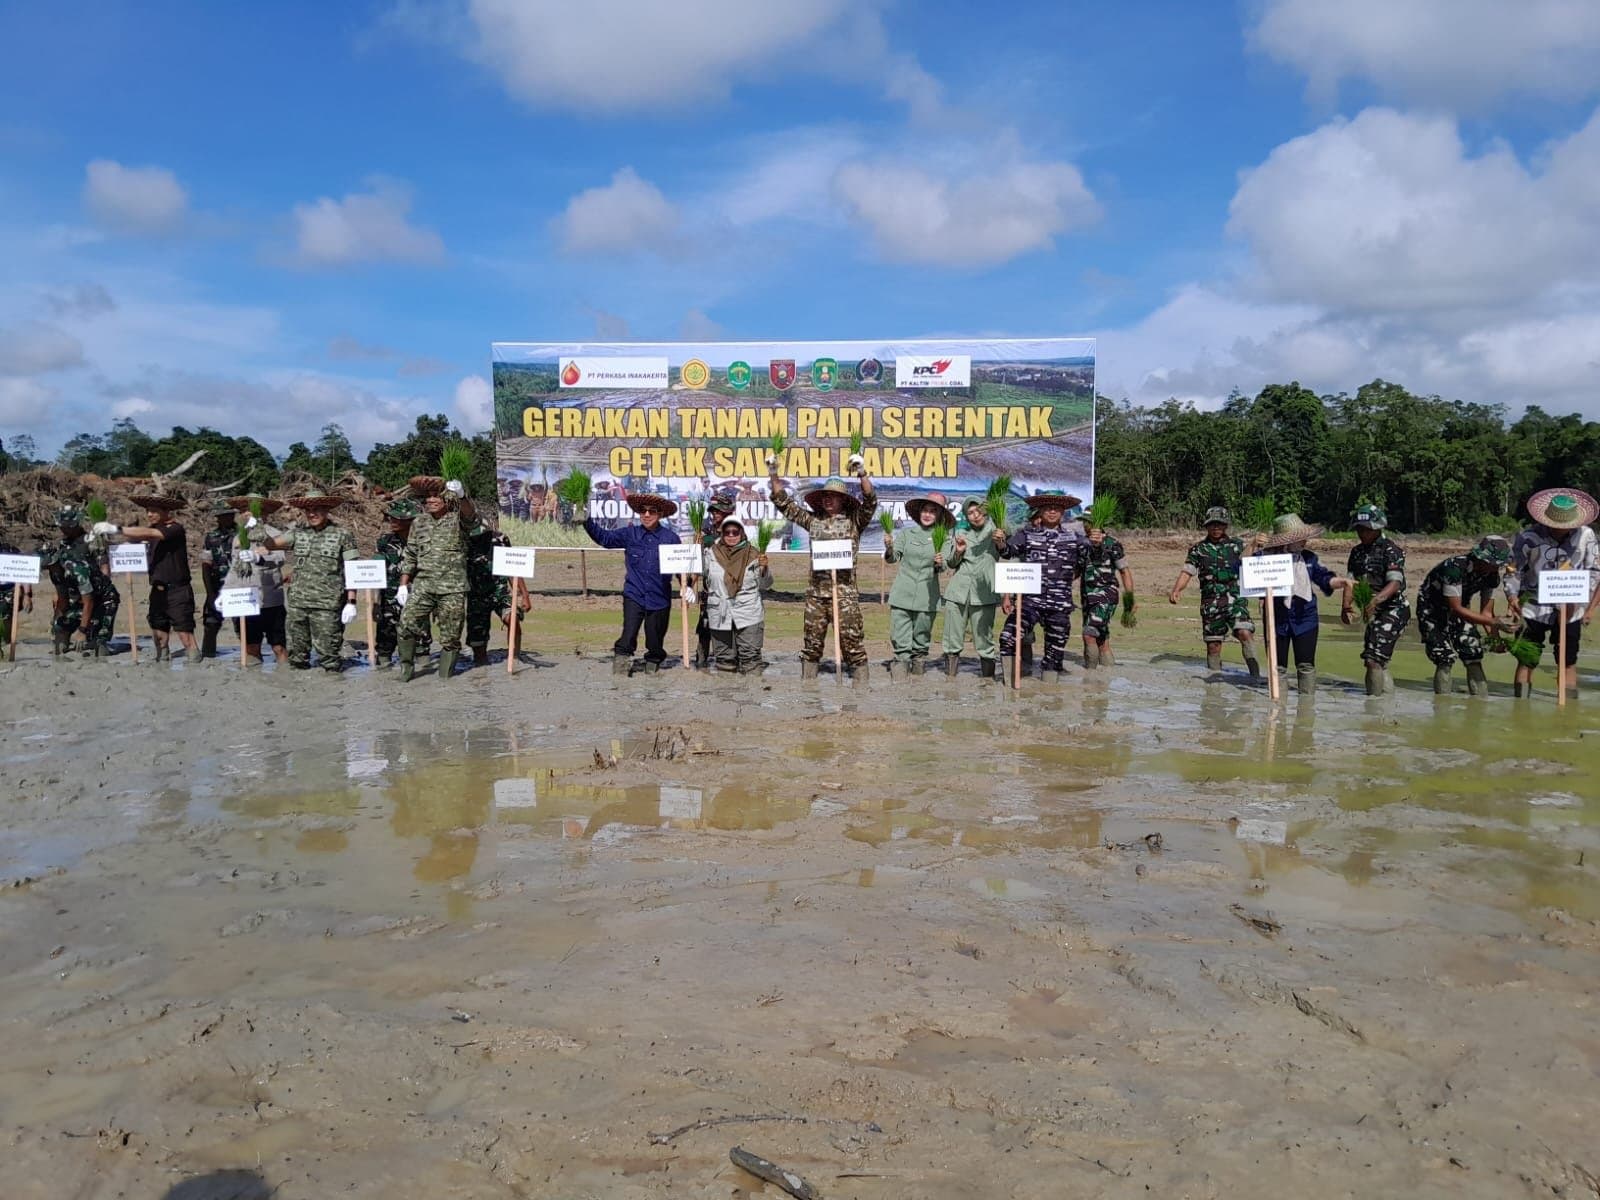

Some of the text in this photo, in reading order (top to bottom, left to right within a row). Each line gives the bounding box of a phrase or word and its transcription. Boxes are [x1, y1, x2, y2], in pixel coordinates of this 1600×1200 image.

[913, 366, 937, 374] KPC
[522, 406, 1053, 438] GERAKAN TANAM PADI SERENTAK
[609, 446, 708, 477] CETAK
